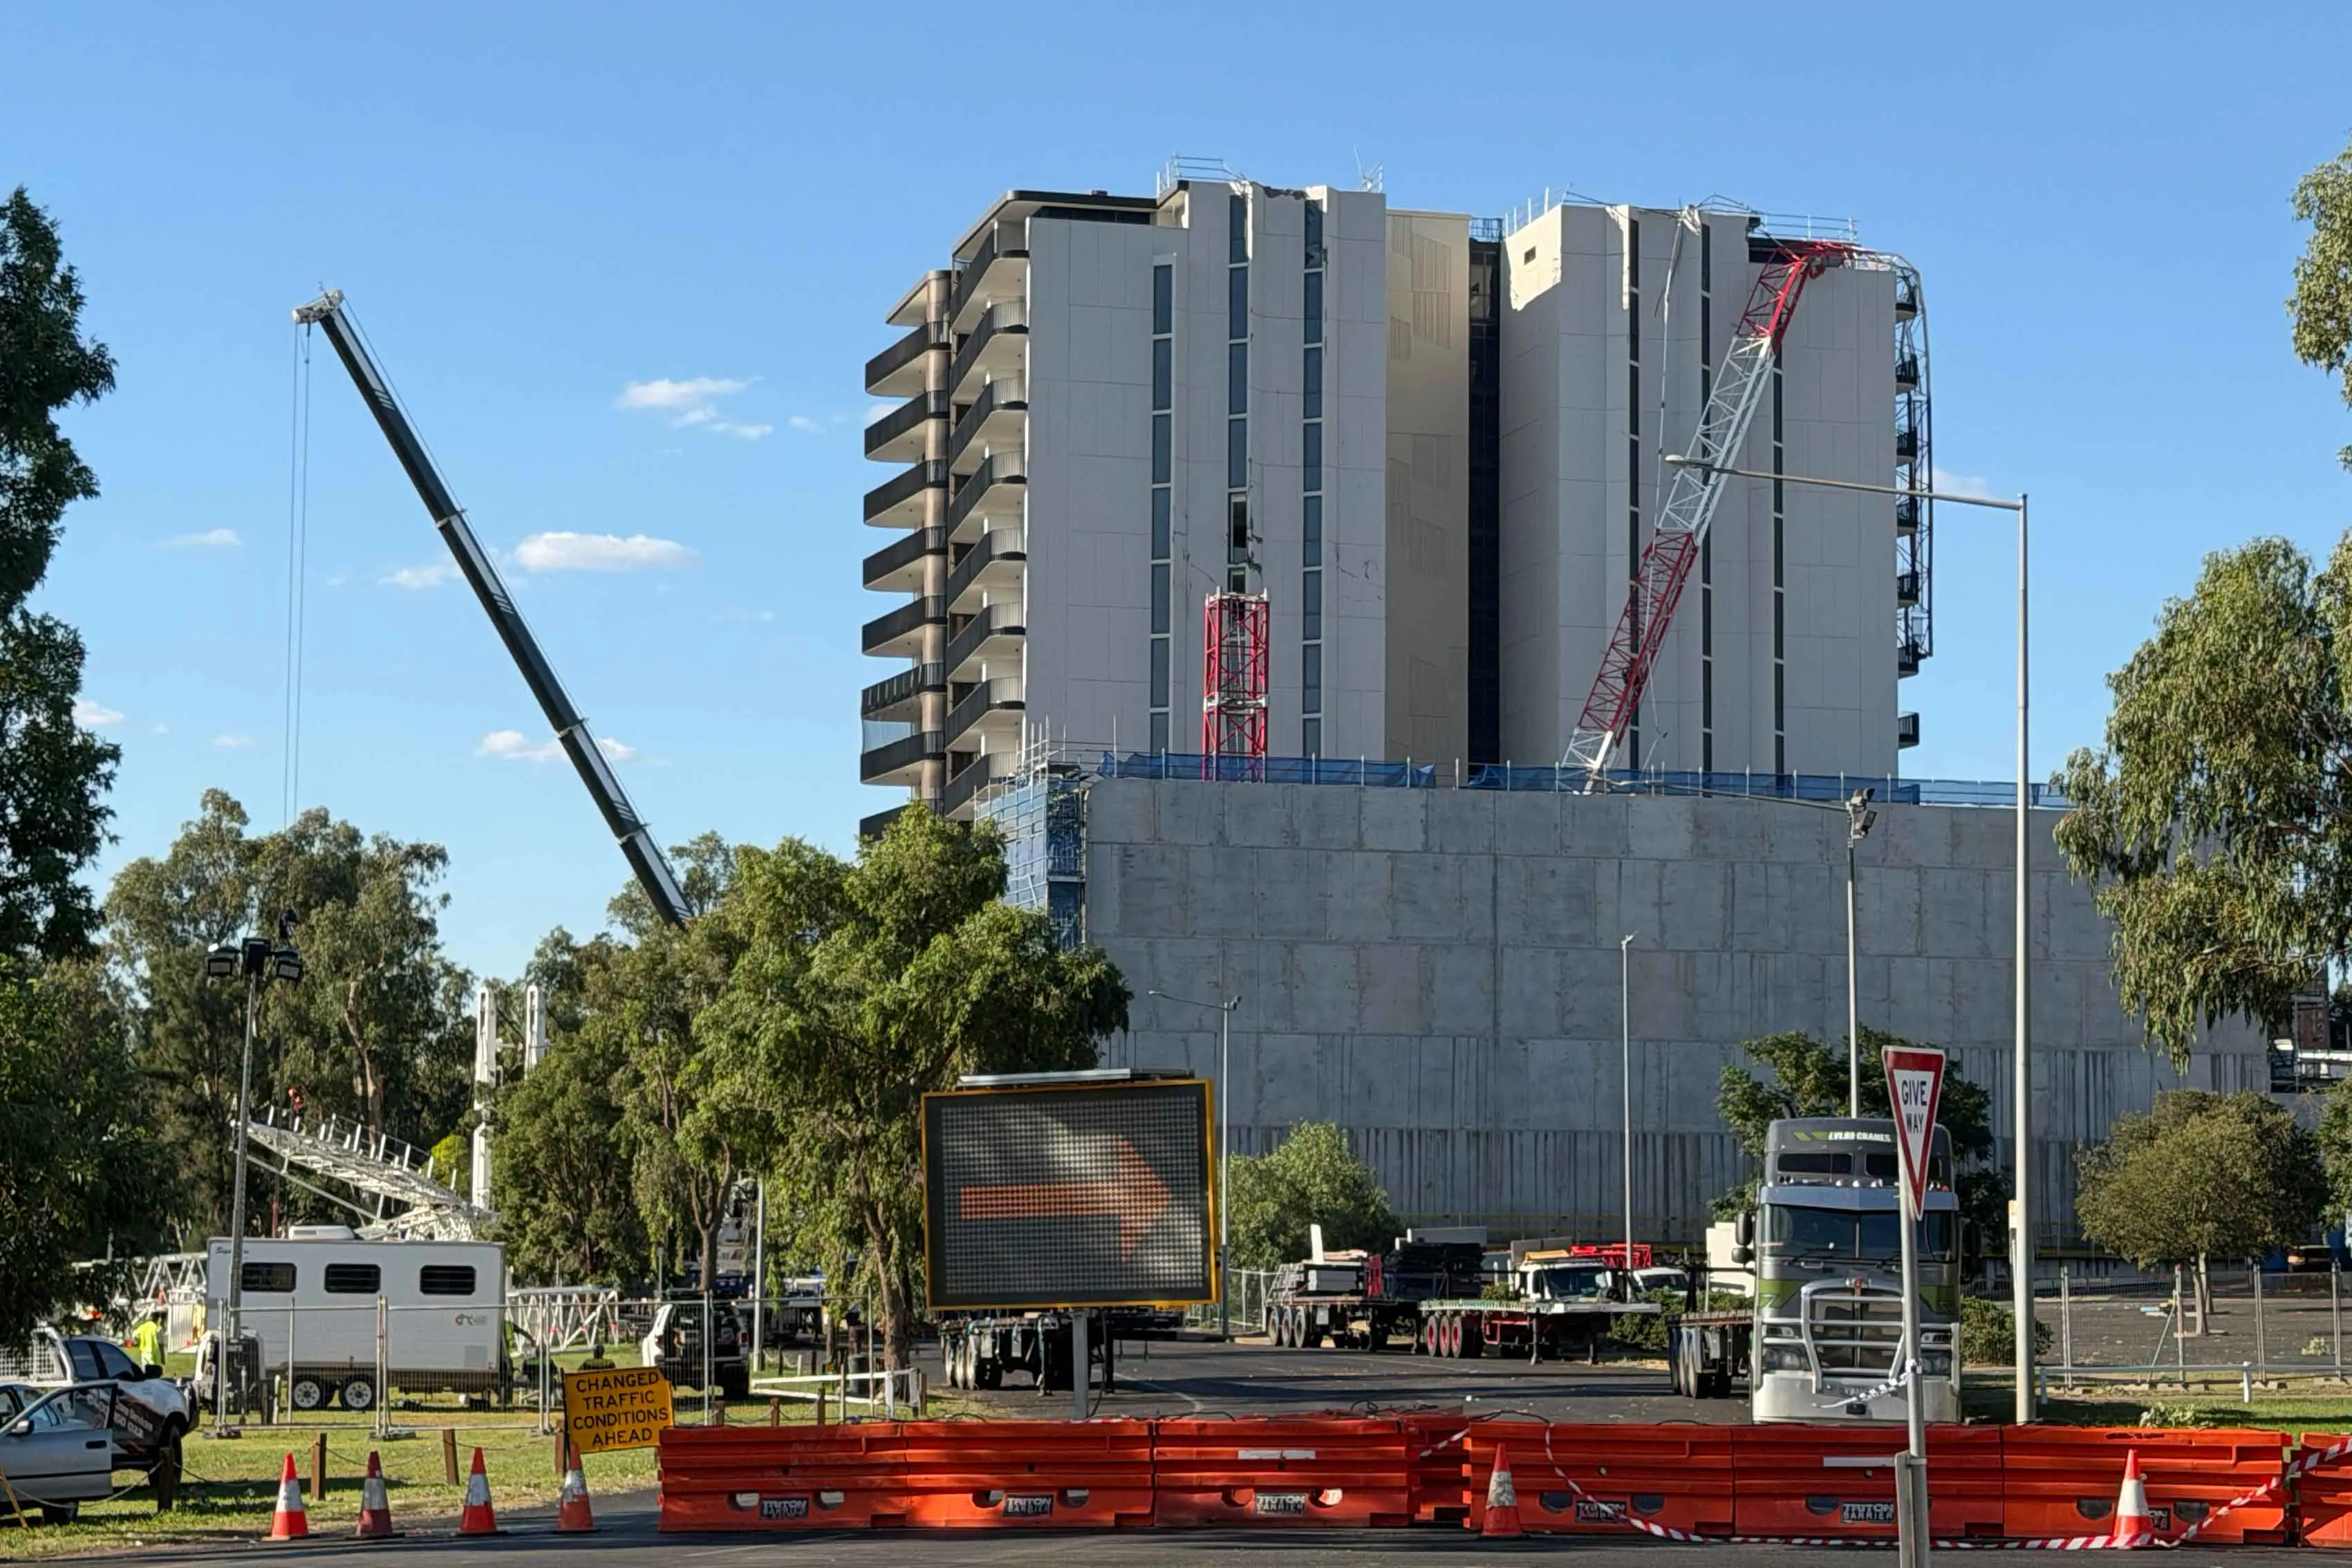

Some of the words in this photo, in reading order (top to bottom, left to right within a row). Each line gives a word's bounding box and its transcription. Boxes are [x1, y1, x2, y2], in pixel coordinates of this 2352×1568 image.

[1901, 1079, 1928, 1106] GIVE
[1905, 1112, 1924, 1134] WAY
[576, 1371, 659, 1393] CHANGED
[582, 1390, 655, 1411] TRAFFIC
[573, 1407, 669, 1430] CONDITIONS
[592, 1428, 653, 1447] AHEAD
[1842, 1504, 1894, 1512] TRITON
